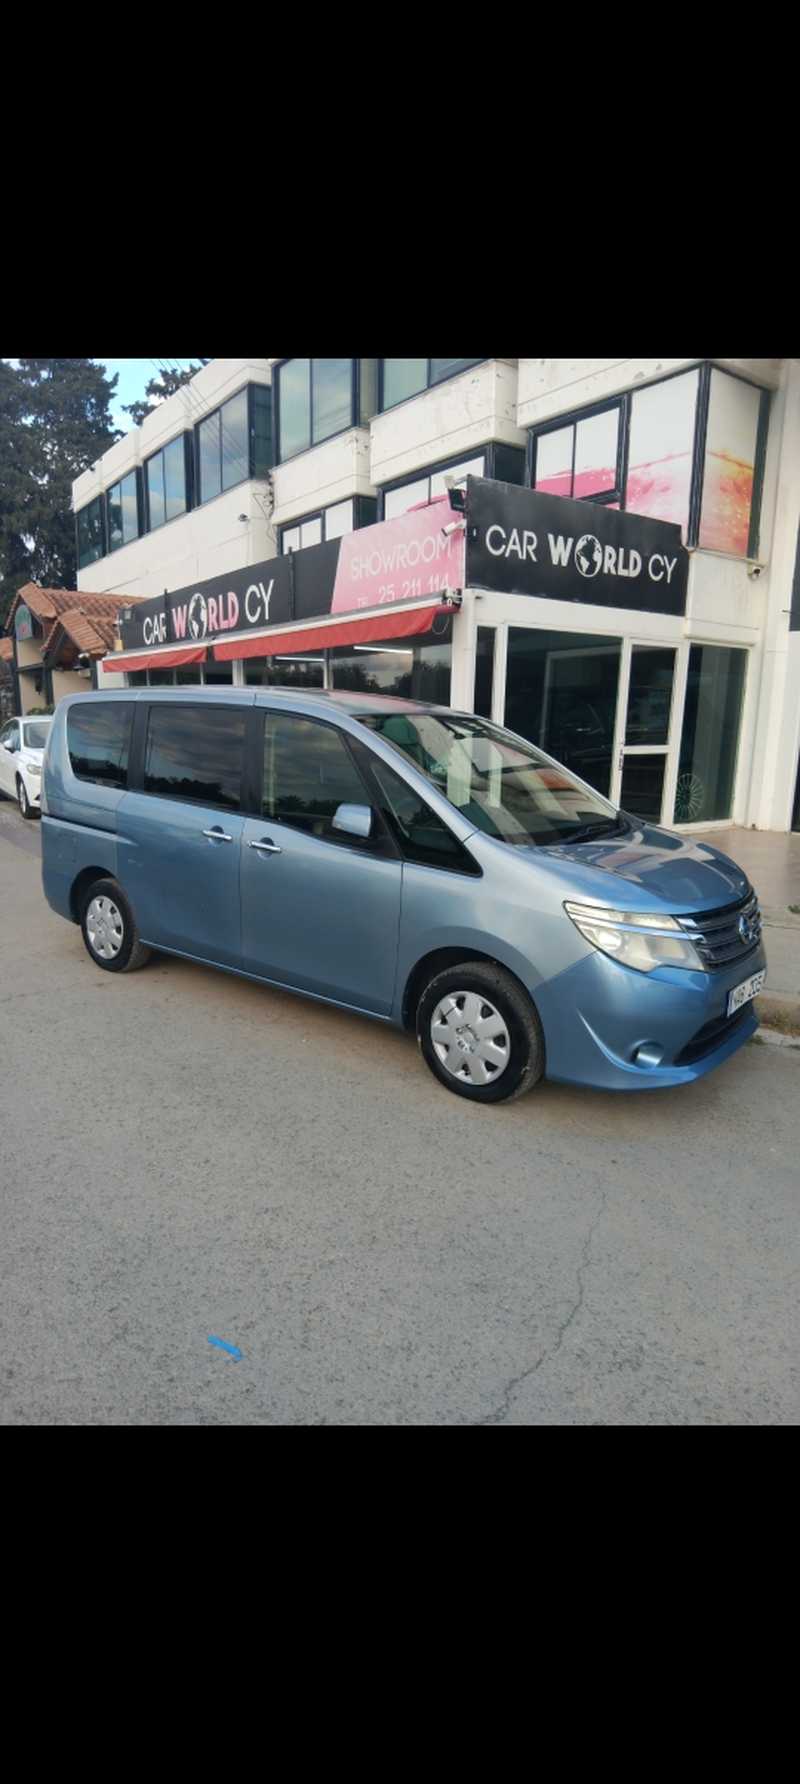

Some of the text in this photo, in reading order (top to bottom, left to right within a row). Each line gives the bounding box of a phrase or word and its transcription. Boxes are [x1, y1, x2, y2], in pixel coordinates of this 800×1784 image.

[351, 533, 452, 581] SHOWROOM
[485, 524, 677, 584] CAR WORLD CY
[171, 591, 239, 640] WORLD
[245, 579, 274, 623] CY
[378, 583, 396, 604] 25
[402, 577, 422, 599] 211
[427, 572, 450, 593] 114
